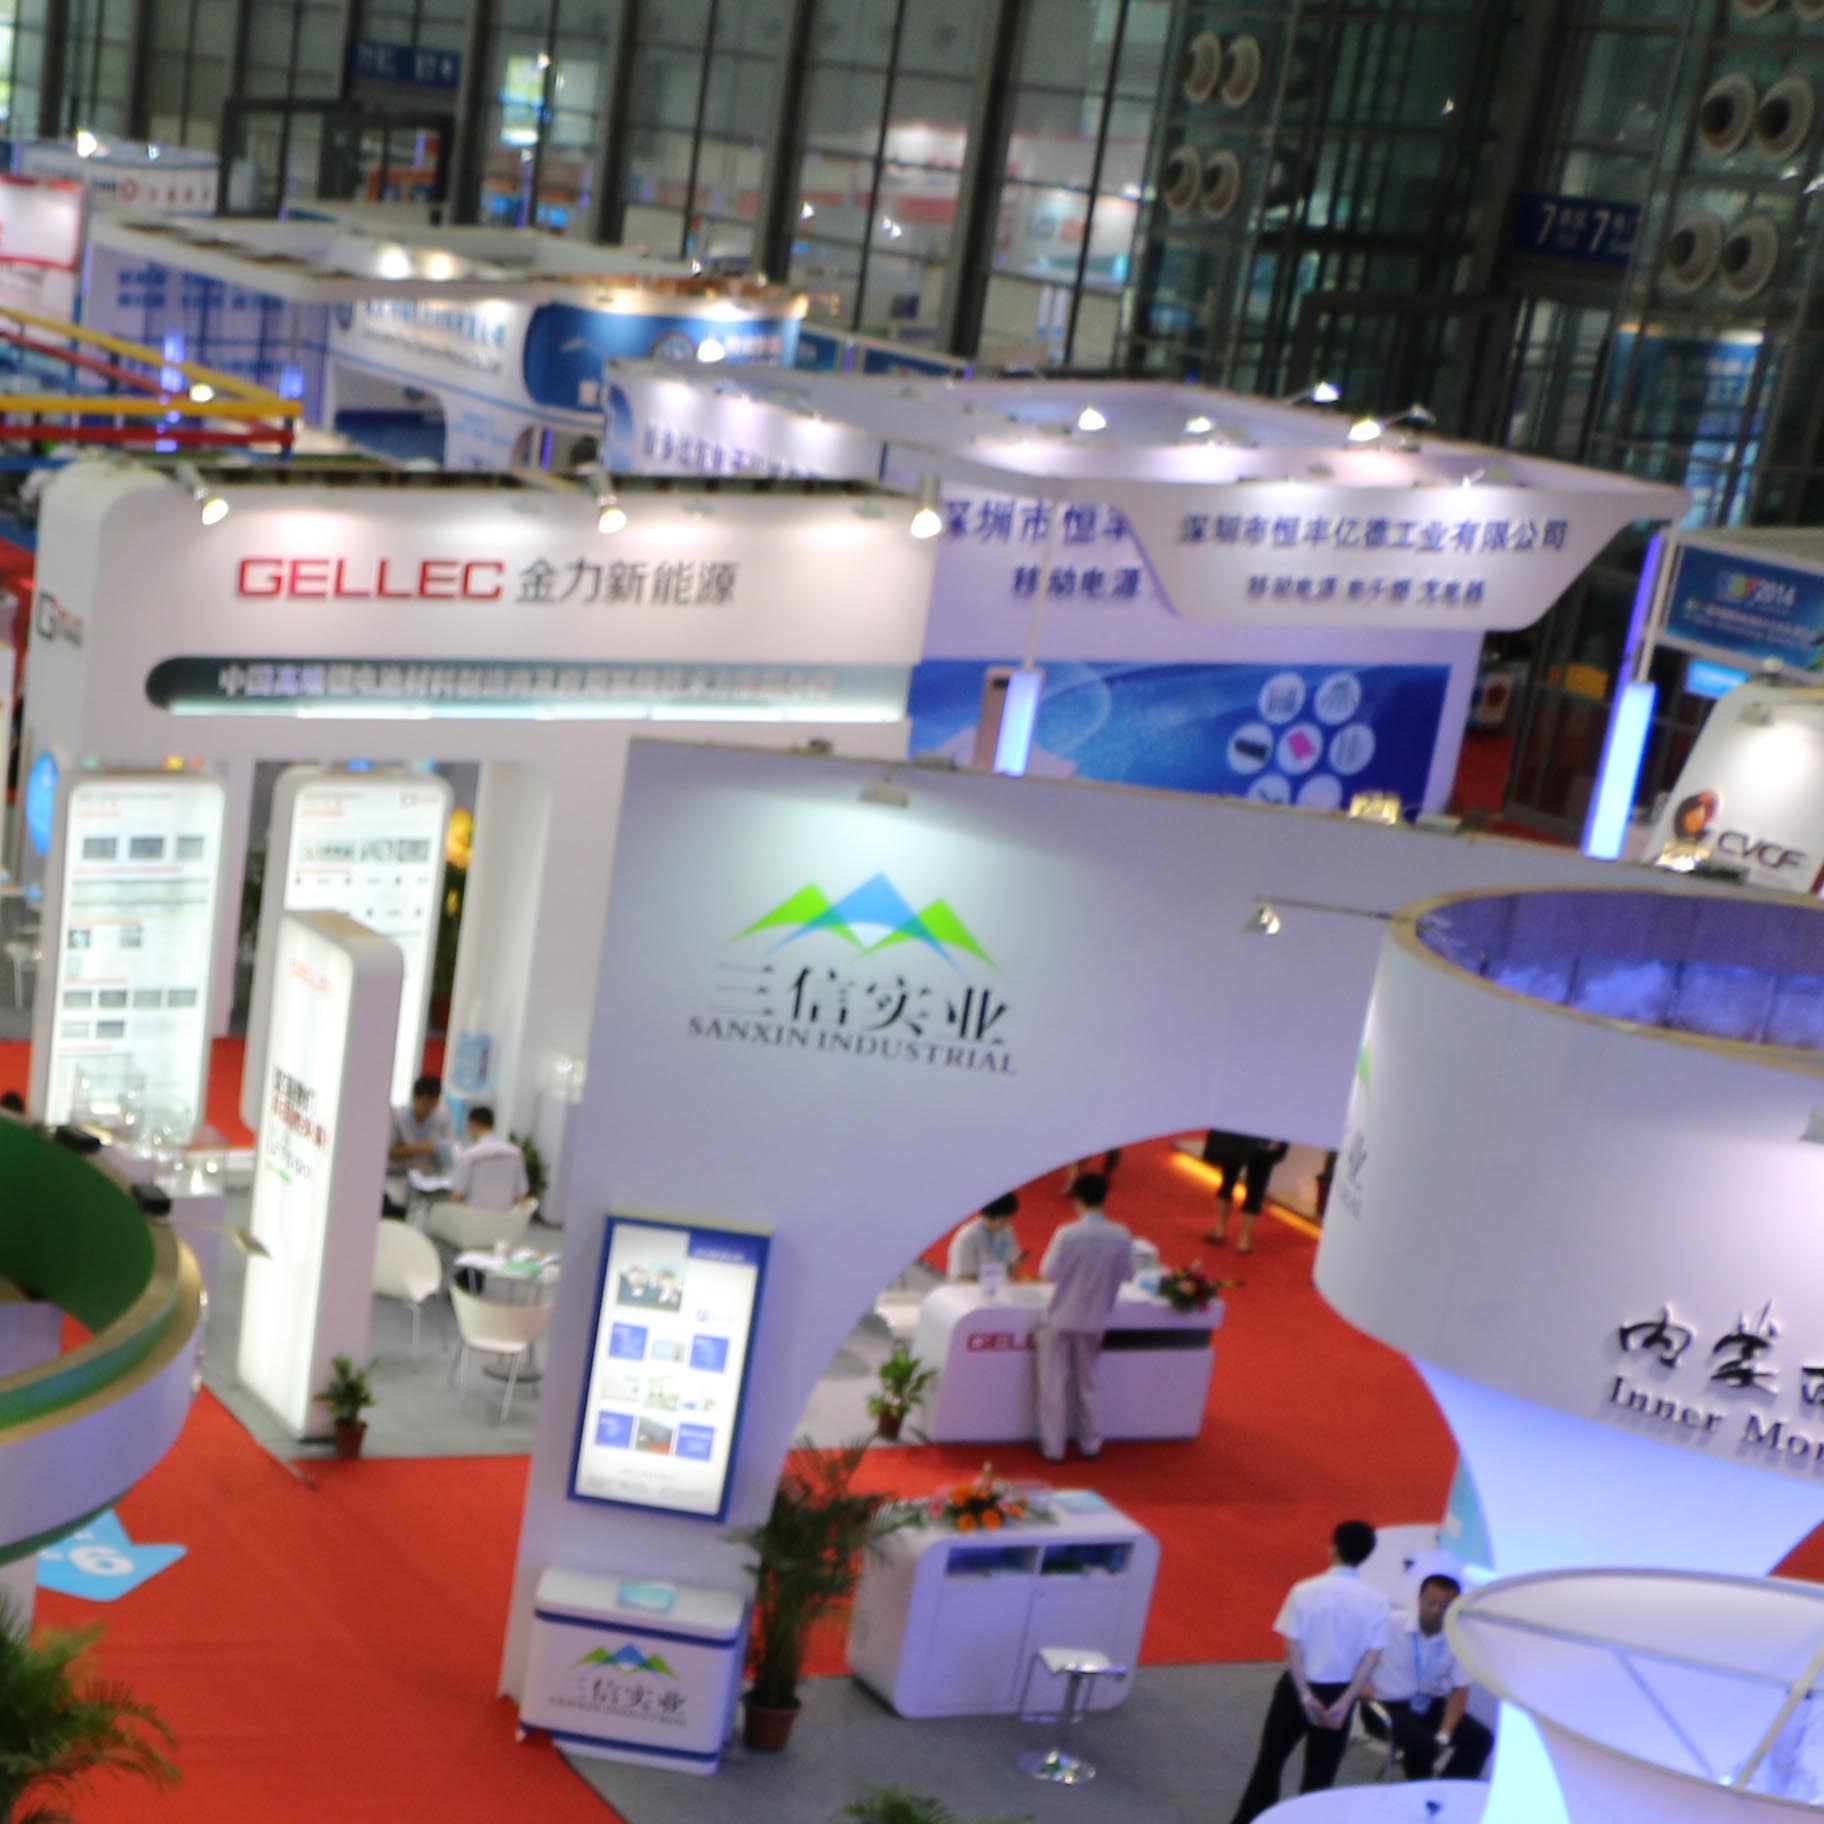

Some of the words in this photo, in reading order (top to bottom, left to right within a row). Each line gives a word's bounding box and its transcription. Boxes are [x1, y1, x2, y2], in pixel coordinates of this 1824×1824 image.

[237, 557, 506, 600] GELLEC
[516, 558, 739, 606] 金力新能源
[708, 962, 1013, 1048] 三信实业
[687, 1013, 807, 1052] SANXIN
[817, 1025, 1018, 1076] INDUSTRIAL
[1618, 1299, 1824, 1406] 内蒙
[1610, 1375, 1724, 1431] Inner
